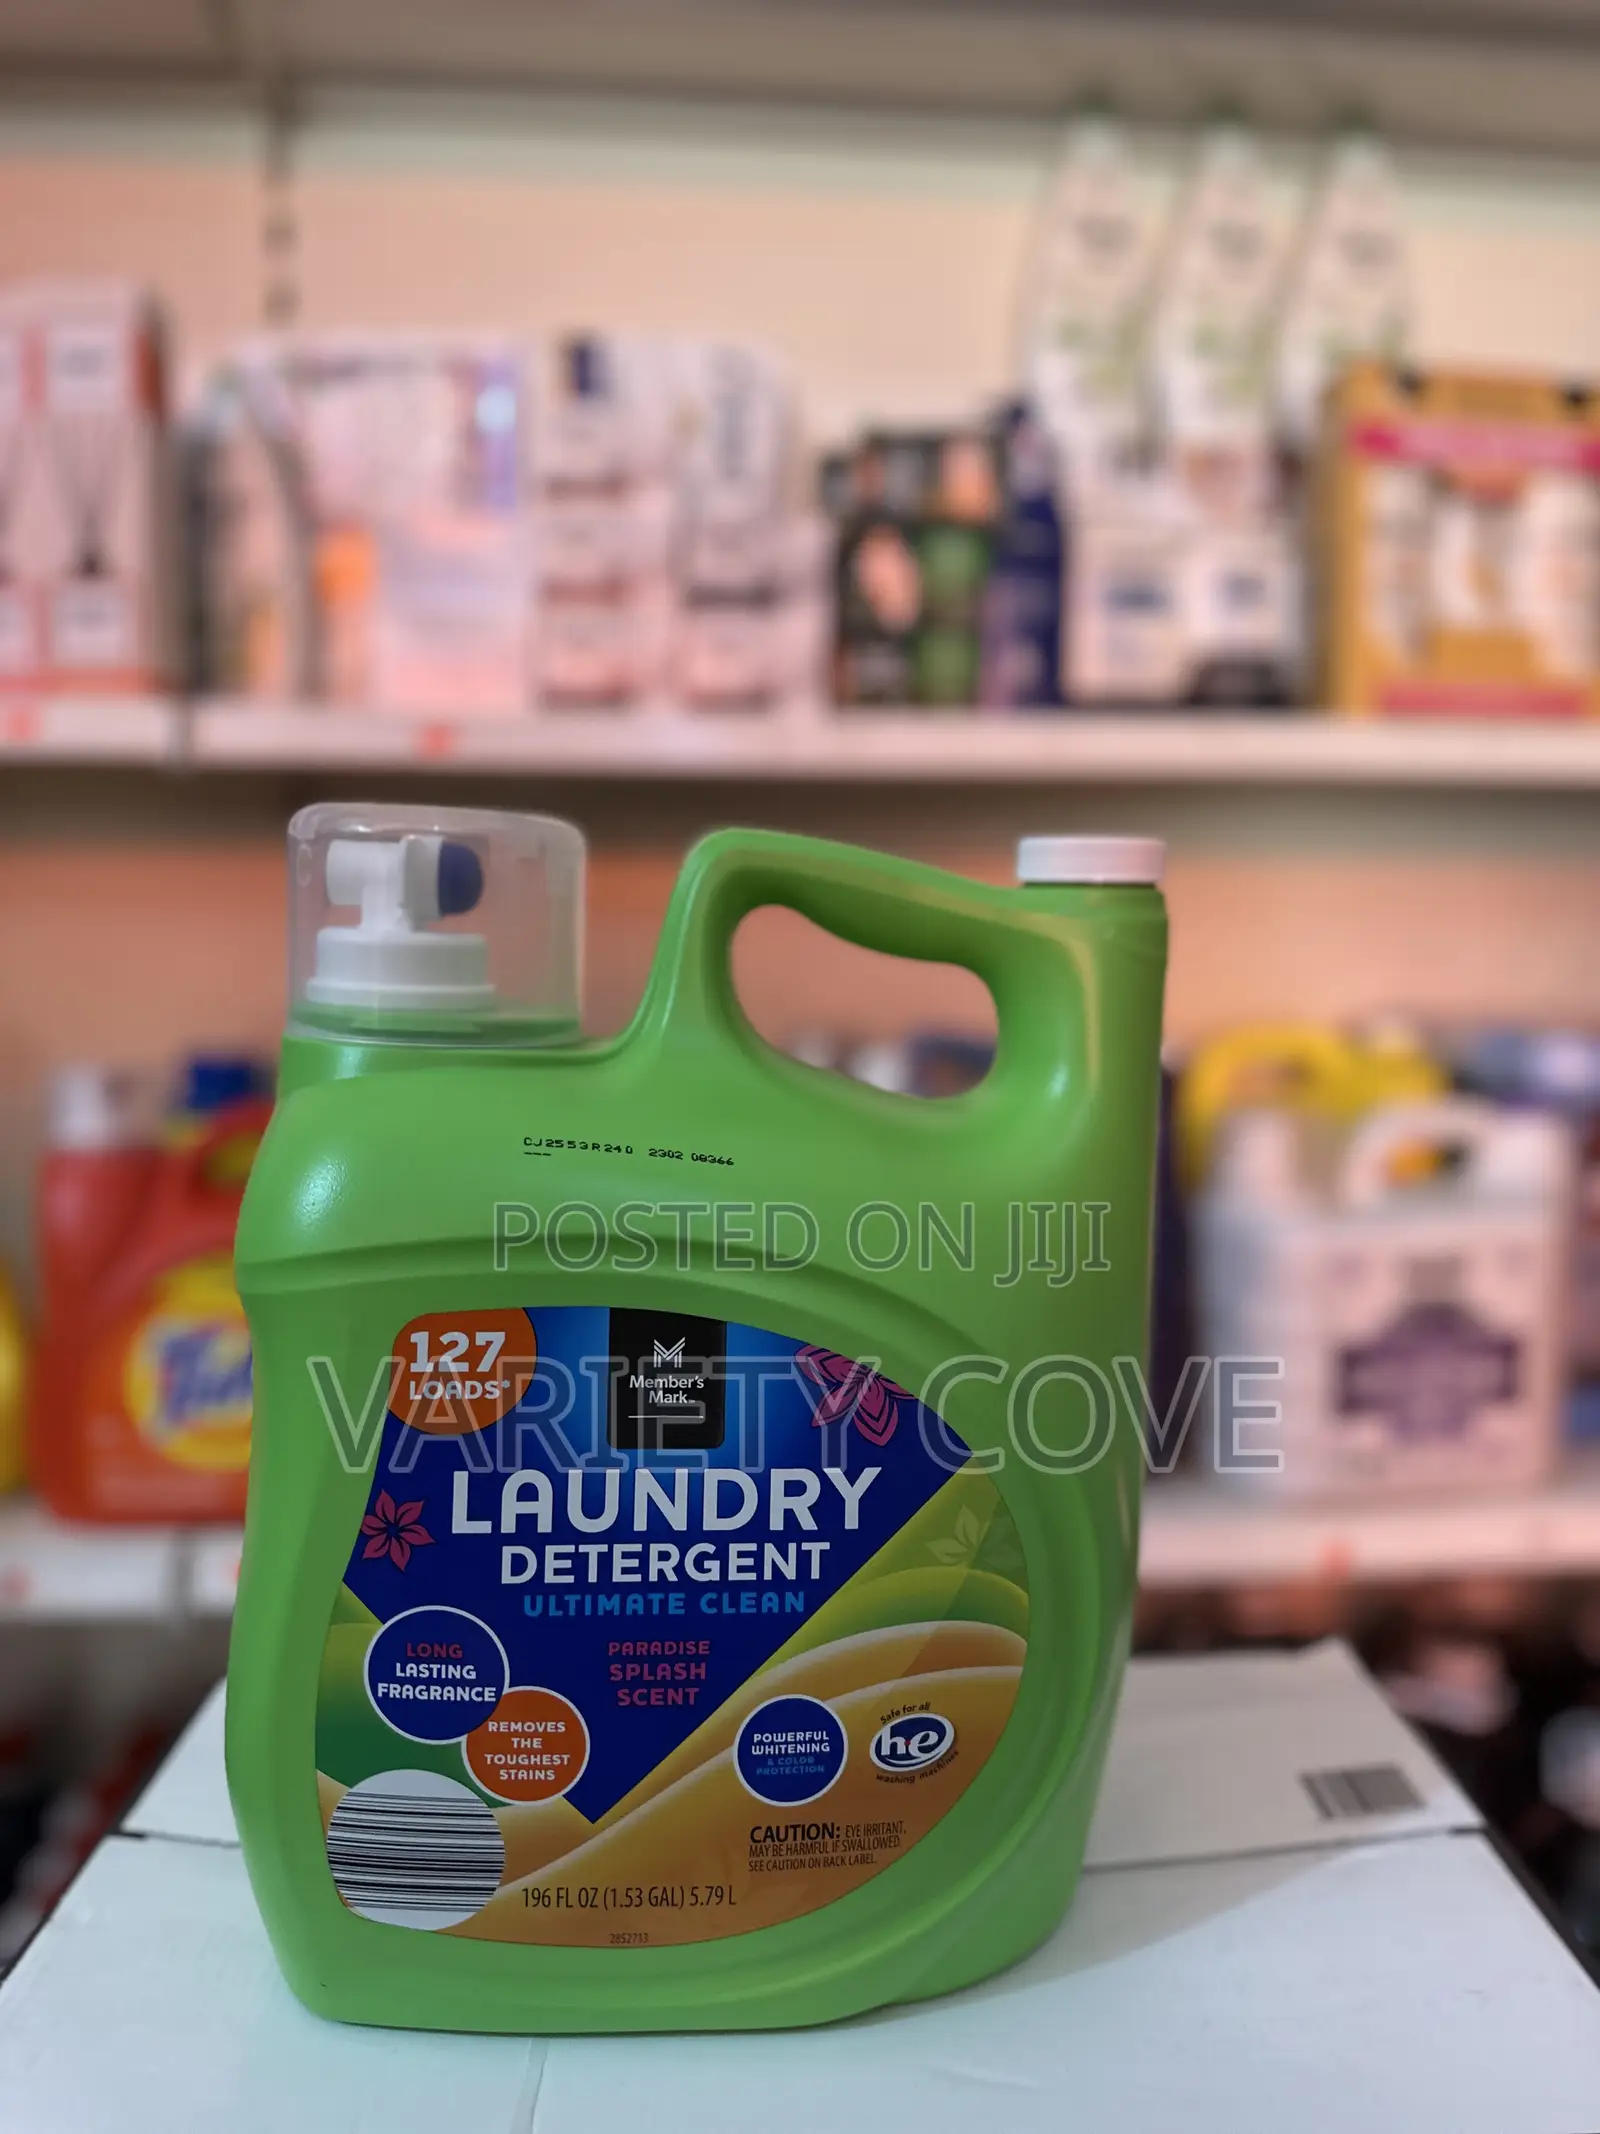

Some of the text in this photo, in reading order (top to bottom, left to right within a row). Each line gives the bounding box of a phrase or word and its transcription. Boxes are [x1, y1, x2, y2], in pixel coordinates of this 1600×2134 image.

[648, 1148, 684, 1161] 2302
[690, 1152, 735, 1166] 08366
[410, 1331, 506, 1373] 127
[450, 1466, 882, 1535] LAUNDRY
[500, 1541, 831, 1585] DETERGENT
[523, 1591, 806, 1617] ULTIMATE CLEAN
[406, 1643, 464, 1659] LONG
[608, 1640, 711, 1656] PARADISE
[395, 1663, 478, 1680] LASTING
[609, 1662, 707, 1681] SPLASH
[376, 1683, 497, 1703] FRAGRANCE
[616, 1687, 700, 1707] SCENT
[880, 1701, 931, 1725] Safe for all
[487, 1721, 566, 1734] REMOVES
[511, 1737, 542, 1749] THE
[753, 1730, 830, 1743] POWERFUL
[751, 1742, 830, 1755] WHITENING
[484, 1753, 571, 1767] TOUGHEST
[778, 1755, 816, 1765] COLOR
[876, 1750, 960, 1785] washing machines
[499, 1769, 556, 1782] STAINS
[756, 1764, 825, 1776] PROTECTION
[750, 1822, 842, 1844] CAUTION:
[845, 1824, 861, 1838] EYE
[749, 1844, 771, 1858] MAY
[772, 1843, 784, 1857] BE
[785, 1840, 830, 1857] HARMFUL
[832, 1838, 840, 1853] IF
[749, 1860, 764, 1872] SEE
[766, 1858, 806, 1872] CAUTION
[808, 1857, 821, 1868] ON
[823, 1855, 847, 1868] BACK
[522, 1885, 737, 1910] 196 FL OZ (1.53 GAL) 5.79 L
[610, 1933, 650, 1944] 2852713
